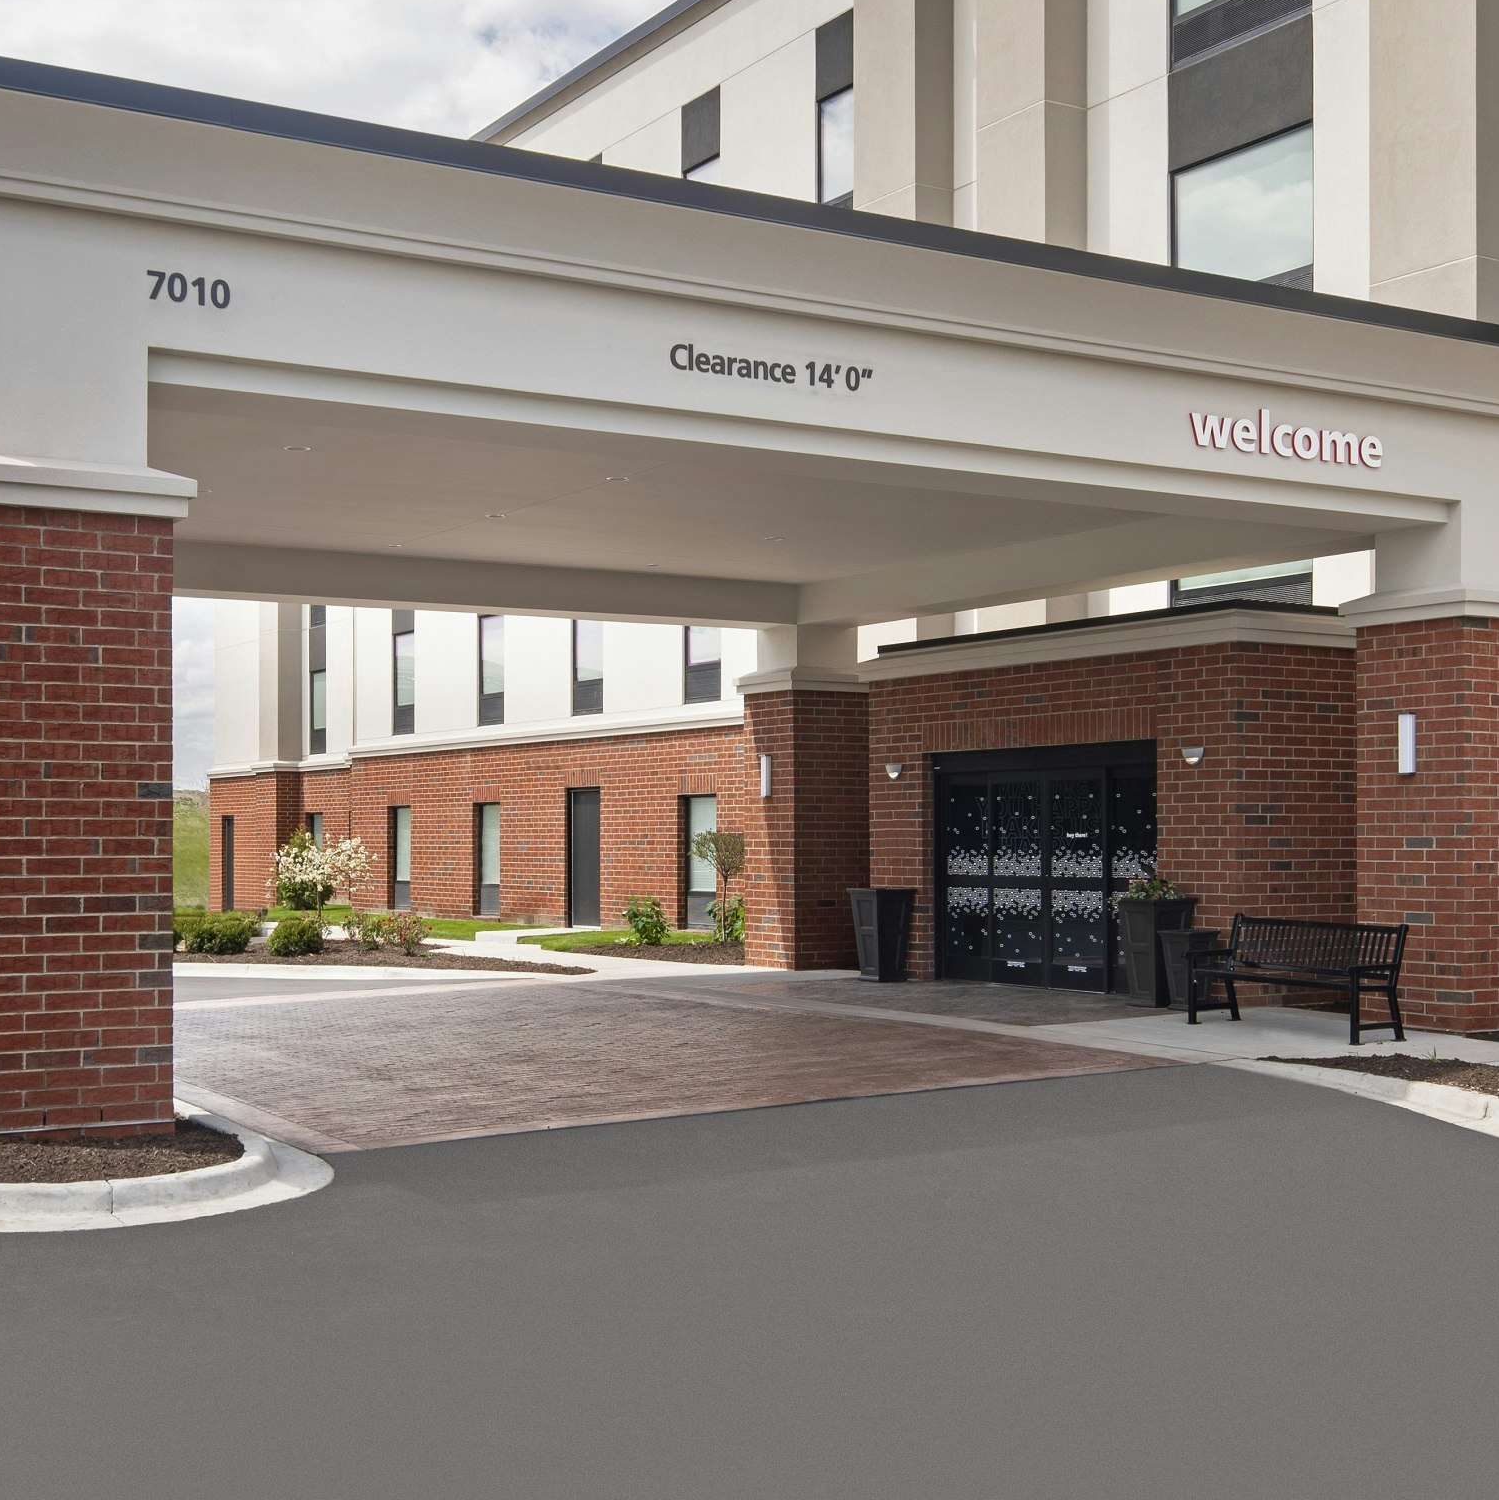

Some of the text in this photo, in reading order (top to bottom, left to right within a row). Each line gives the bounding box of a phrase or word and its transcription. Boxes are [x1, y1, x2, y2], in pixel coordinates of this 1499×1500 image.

[146, 269, 231, 309] 7010
[669, 343, 797, 384] Clearance
[1189, 408, 1383, 469] welcome
